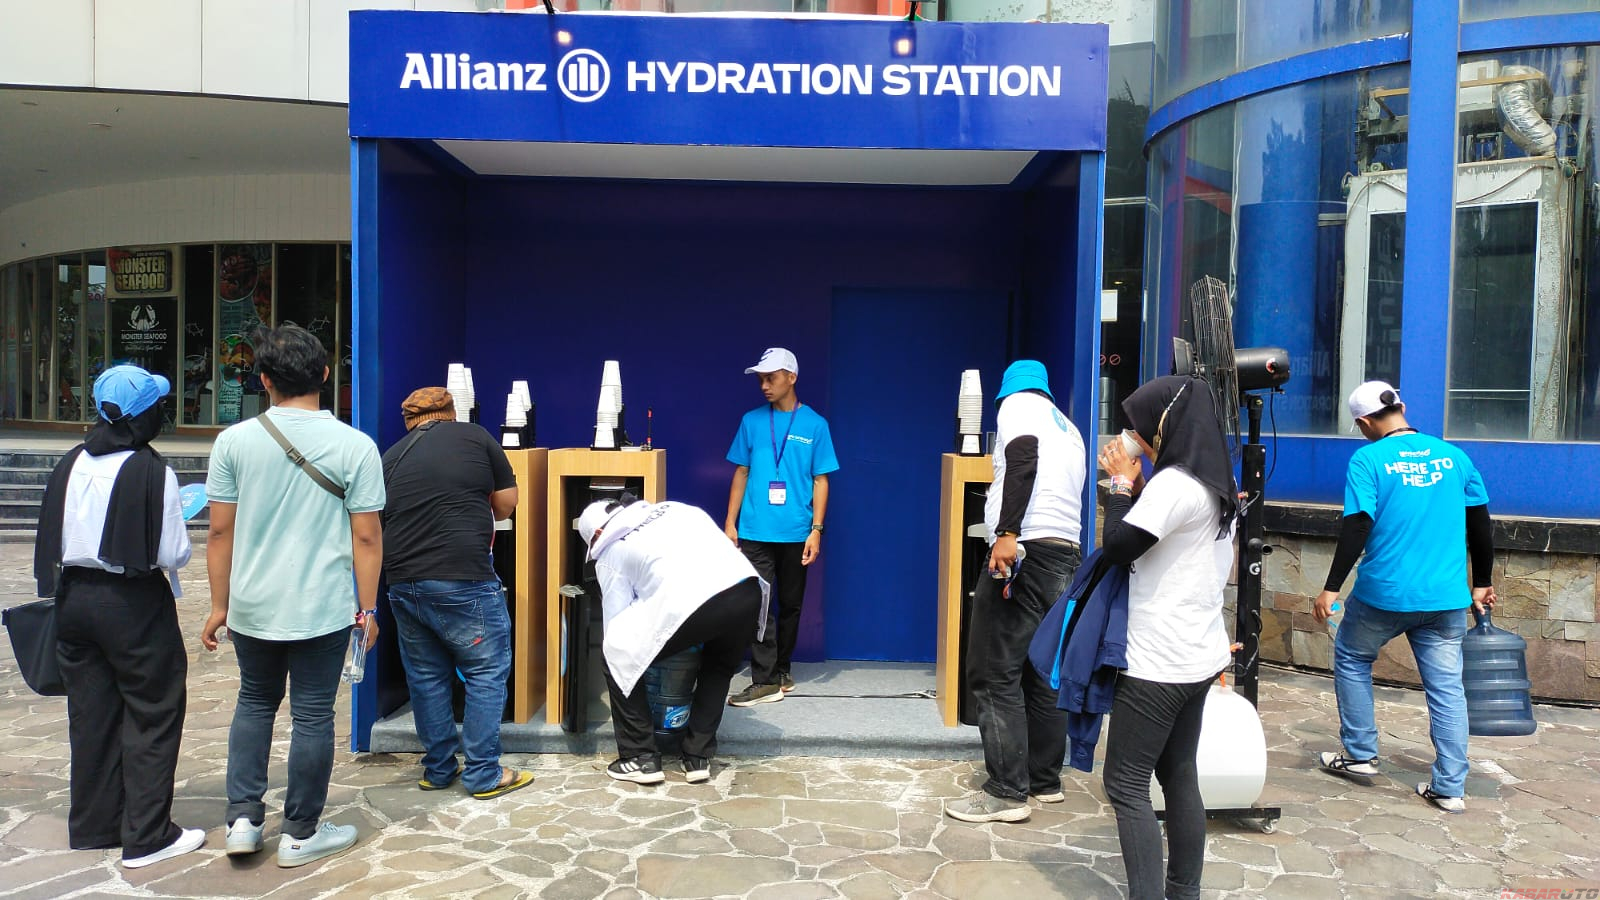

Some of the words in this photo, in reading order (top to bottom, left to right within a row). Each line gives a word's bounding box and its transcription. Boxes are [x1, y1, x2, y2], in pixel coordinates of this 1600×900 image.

[400, 52, 547, 92] Allianz
[627, 60, 874, 96] HYDRATION
[881, 63, 1062, 98] STATION
[115, 256, 165, 273] MONSTER
[115, 273, 165, 290] SEAFOOD
[1384, 461, 1429, 475] HERE
[1429, 457, 1454, 471] TO
[1402, 472, 1443, 487] HELP
